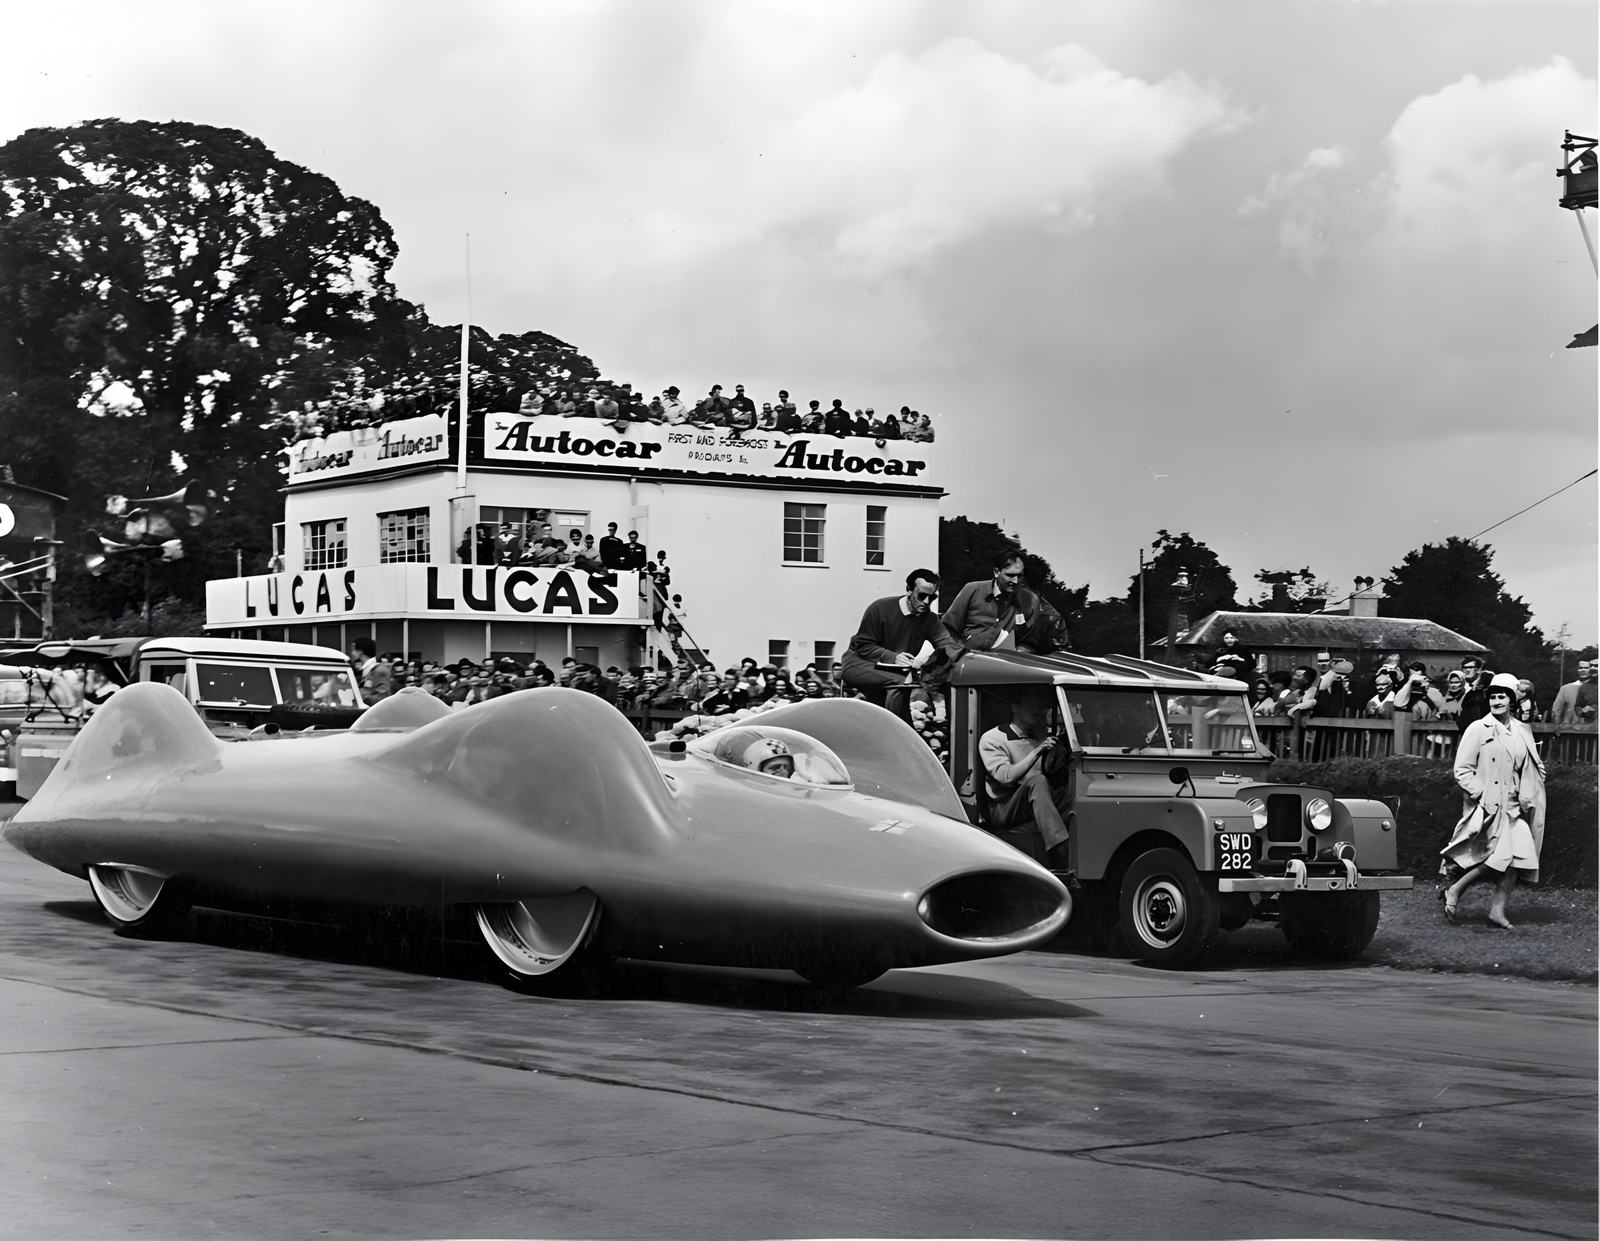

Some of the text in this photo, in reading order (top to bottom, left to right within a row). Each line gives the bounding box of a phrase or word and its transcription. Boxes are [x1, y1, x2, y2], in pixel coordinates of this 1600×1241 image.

[495, 421, 662, 459] Autocar
[774, 439, 926, 477] Autocar
[246, 569, 356, 618] LUCAS
[427, 566, 619, 616] LUCAS
[1220, 833, 1252, 851] SWD
[1221, 852, 1252, 870] 282
